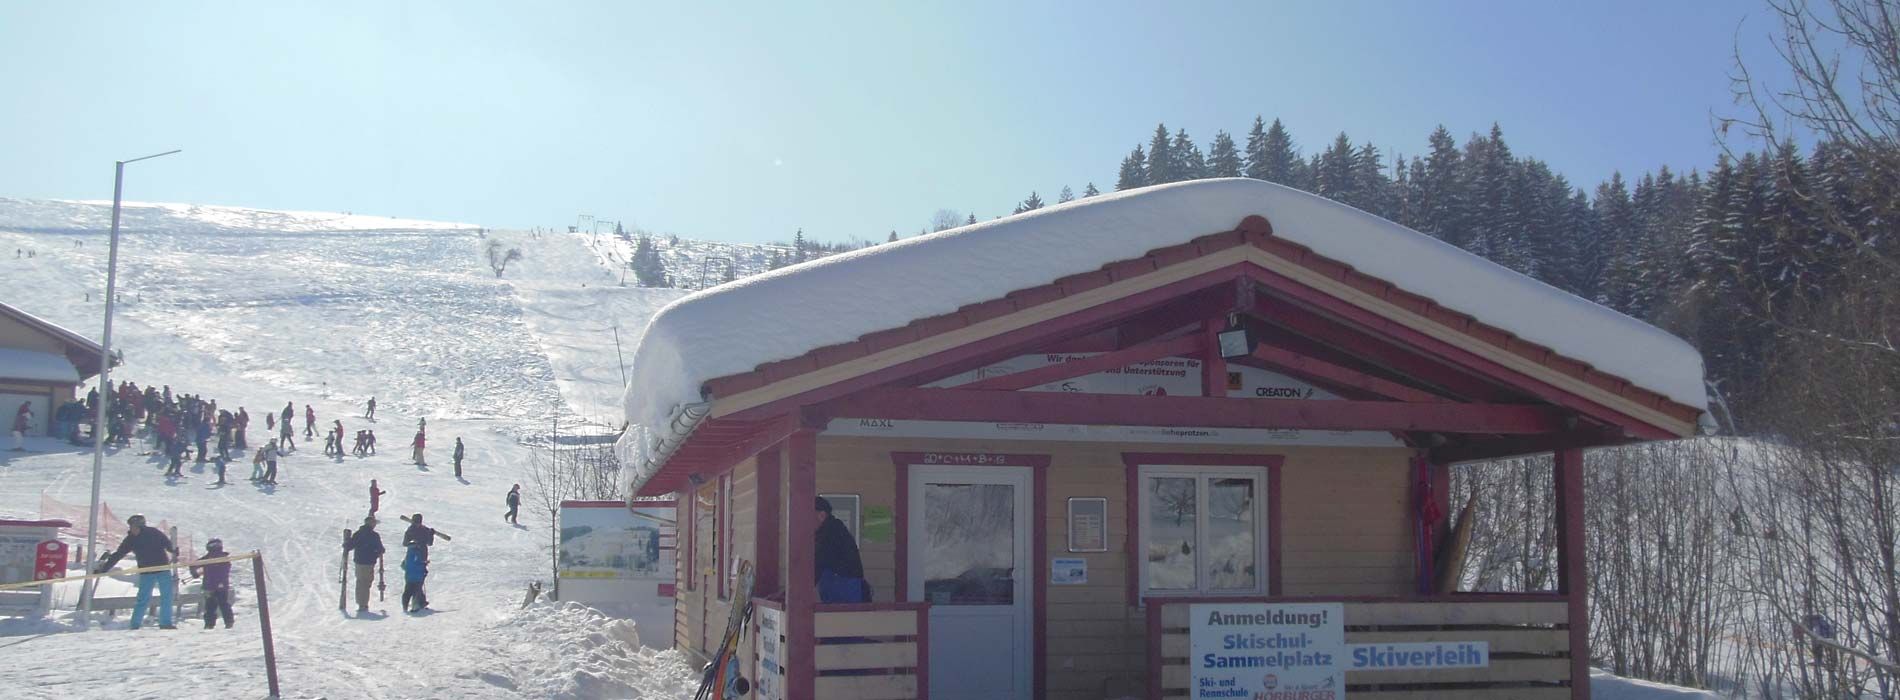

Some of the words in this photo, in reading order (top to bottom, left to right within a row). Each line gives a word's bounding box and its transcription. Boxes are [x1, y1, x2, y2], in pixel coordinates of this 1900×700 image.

[1048, 354, 1063, 363] Wir
[1187, 359, 1200, 368] für
[1124, 366, 1186, 378] Unterstützung
[1256, 387, 1301, 397] CREATON
[1208, 610, 1328, 629] Anmeldung!
[1223, 633, 1312, 650] Skischul-
[1203, 651, 1332, 672] Sammelplatz
[1353, 645, 1481, 668] Skiverleih
[1200, 677, 1217, 688] Ski-
[1219, 676, 1235, 687] und
[1200, 687, 1249, 699] Rennschule
